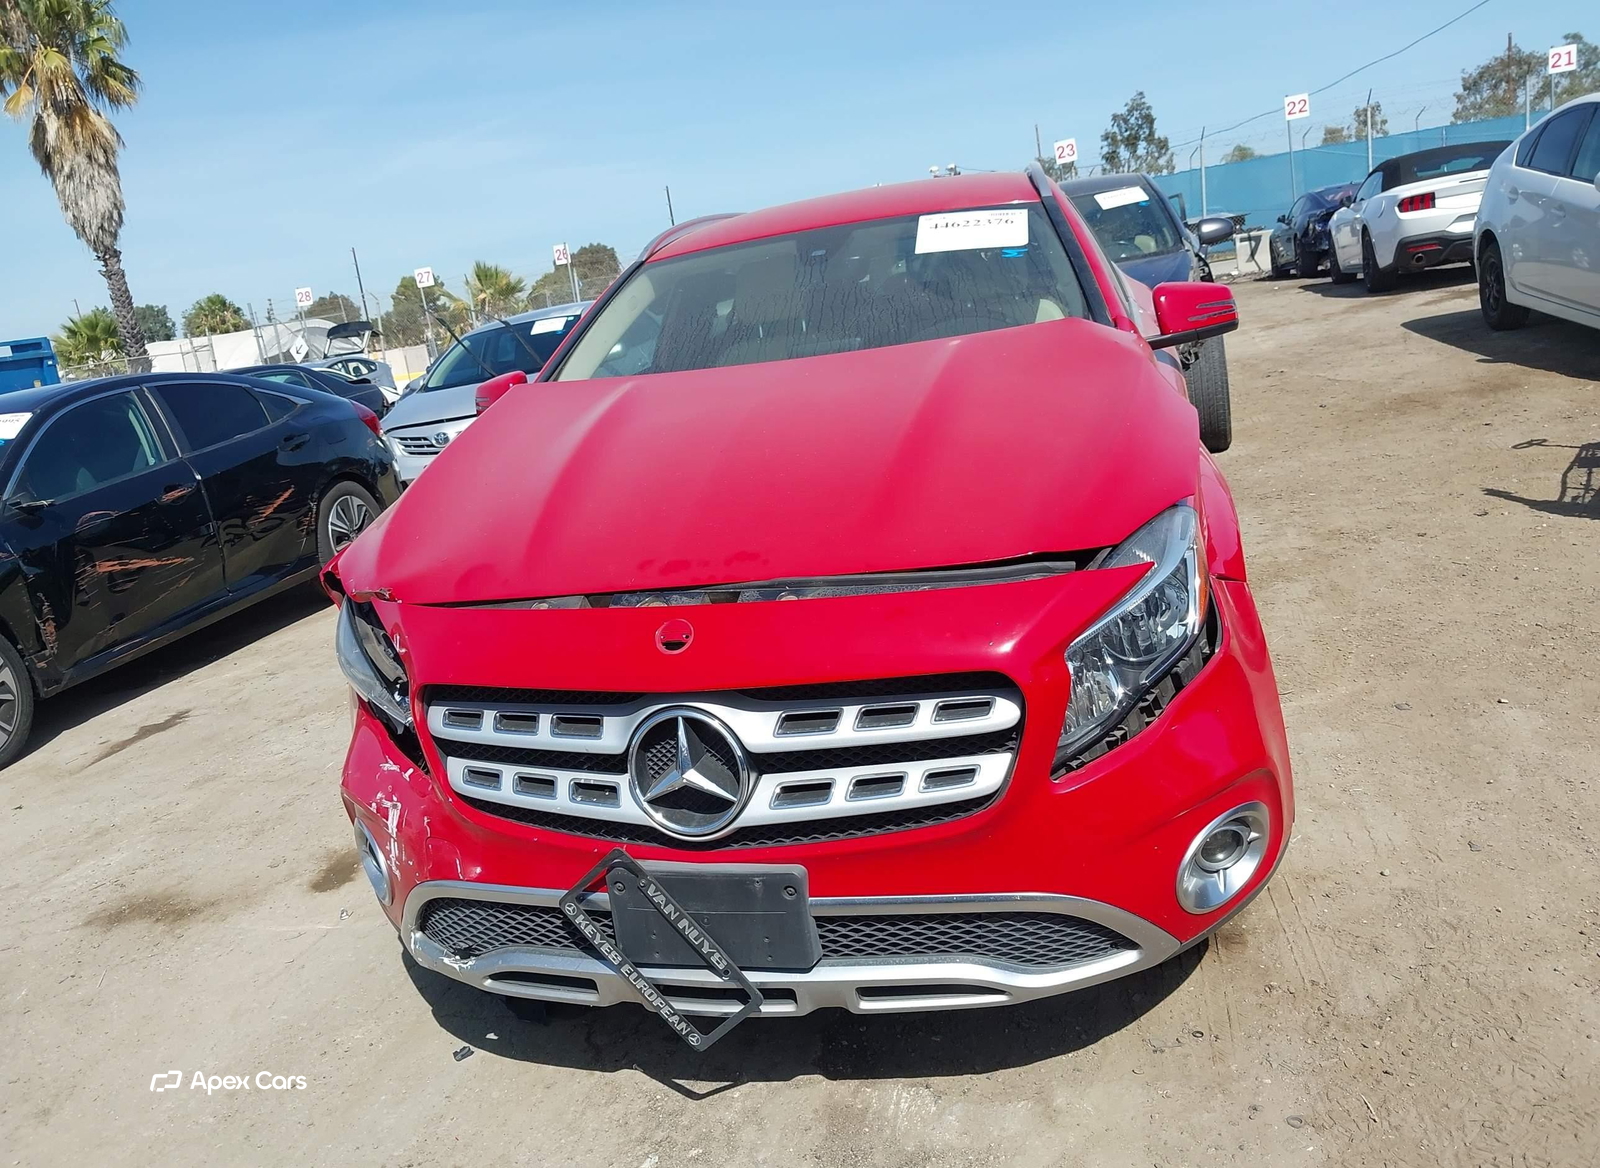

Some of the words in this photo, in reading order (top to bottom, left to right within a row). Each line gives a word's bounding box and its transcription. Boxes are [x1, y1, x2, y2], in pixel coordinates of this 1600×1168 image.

[1551, 50, 1574, 68] 21
[1287, 99, 1308, 115] 22
[1056, 143, 1075, 159] 23
[416, 271, 431, 283] 27
[297, 291, 311, 302] 28
[647, 883, 679, 920] VAN
[677, 918, 728, 970] NUYS
[575, 915, 622, 965] KEYES
[620, 964, 691, 1034] EUROPEAN
